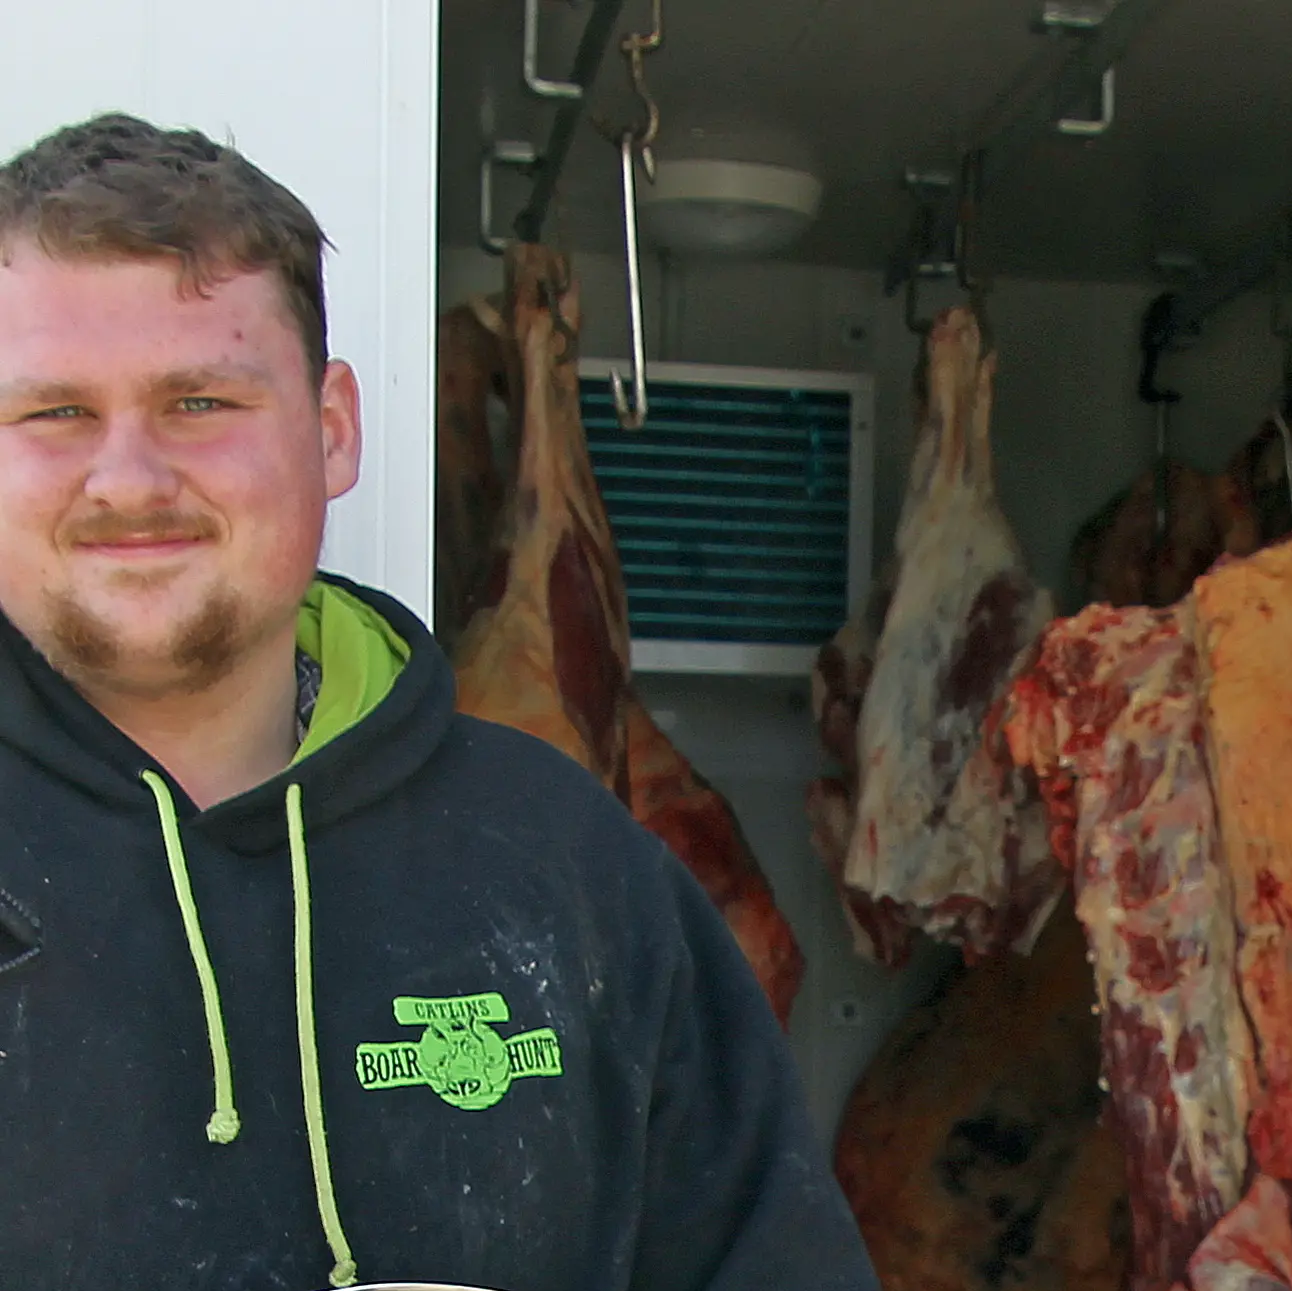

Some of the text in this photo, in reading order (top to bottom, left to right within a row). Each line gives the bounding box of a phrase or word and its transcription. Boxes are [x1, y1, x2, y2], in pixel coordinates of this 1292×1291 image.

[414, 999, 490, 1018] CATLINS
[360, 1035, 560, 1085] BOAR HUNT
